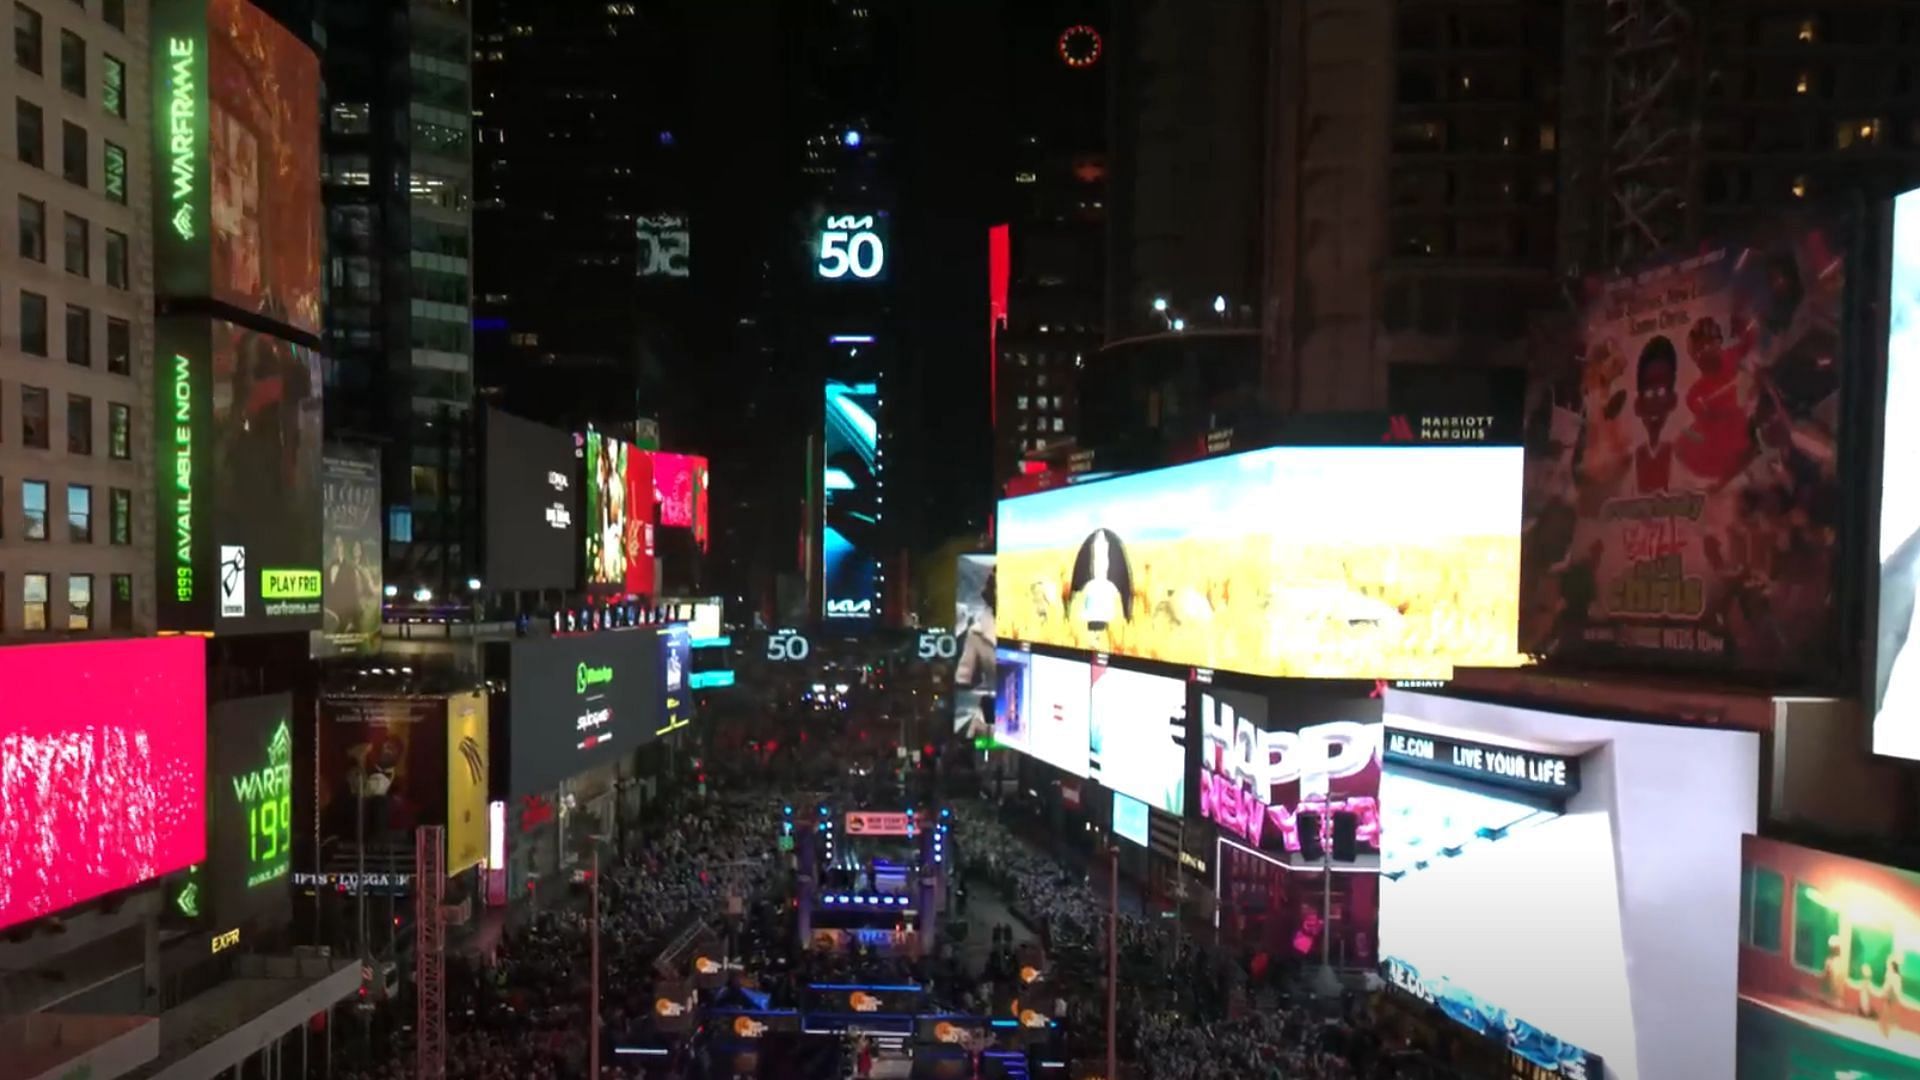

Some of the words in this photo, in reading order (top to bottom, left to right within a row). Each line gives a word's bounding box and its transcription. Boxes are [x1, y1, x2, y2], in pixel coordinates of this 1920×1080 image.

[170, 37, 194, 199] WARFRAME
[819, 231, 884, 278] 50
[175, 354, 191, 421] NOW
[1421, 415, 1494, 428] MARRIOTT
[1421, 428, 1485, 440] MARQUIS
[175, 426, 192, 562] AVAILABLE
[269, 575, 296, 593] PLAY
[767, 635, 810, 661] 50
[917, 634, 957, 659] 50
[1389, 734, 1435, 760] AE.COM
[1453, 745, 1483, 769] LIVE
[1485, 751, 1526, 779] YOUR
[1529, 758, 1566, 786] LIFE
[1201, 767, 1264, 848] NEW
